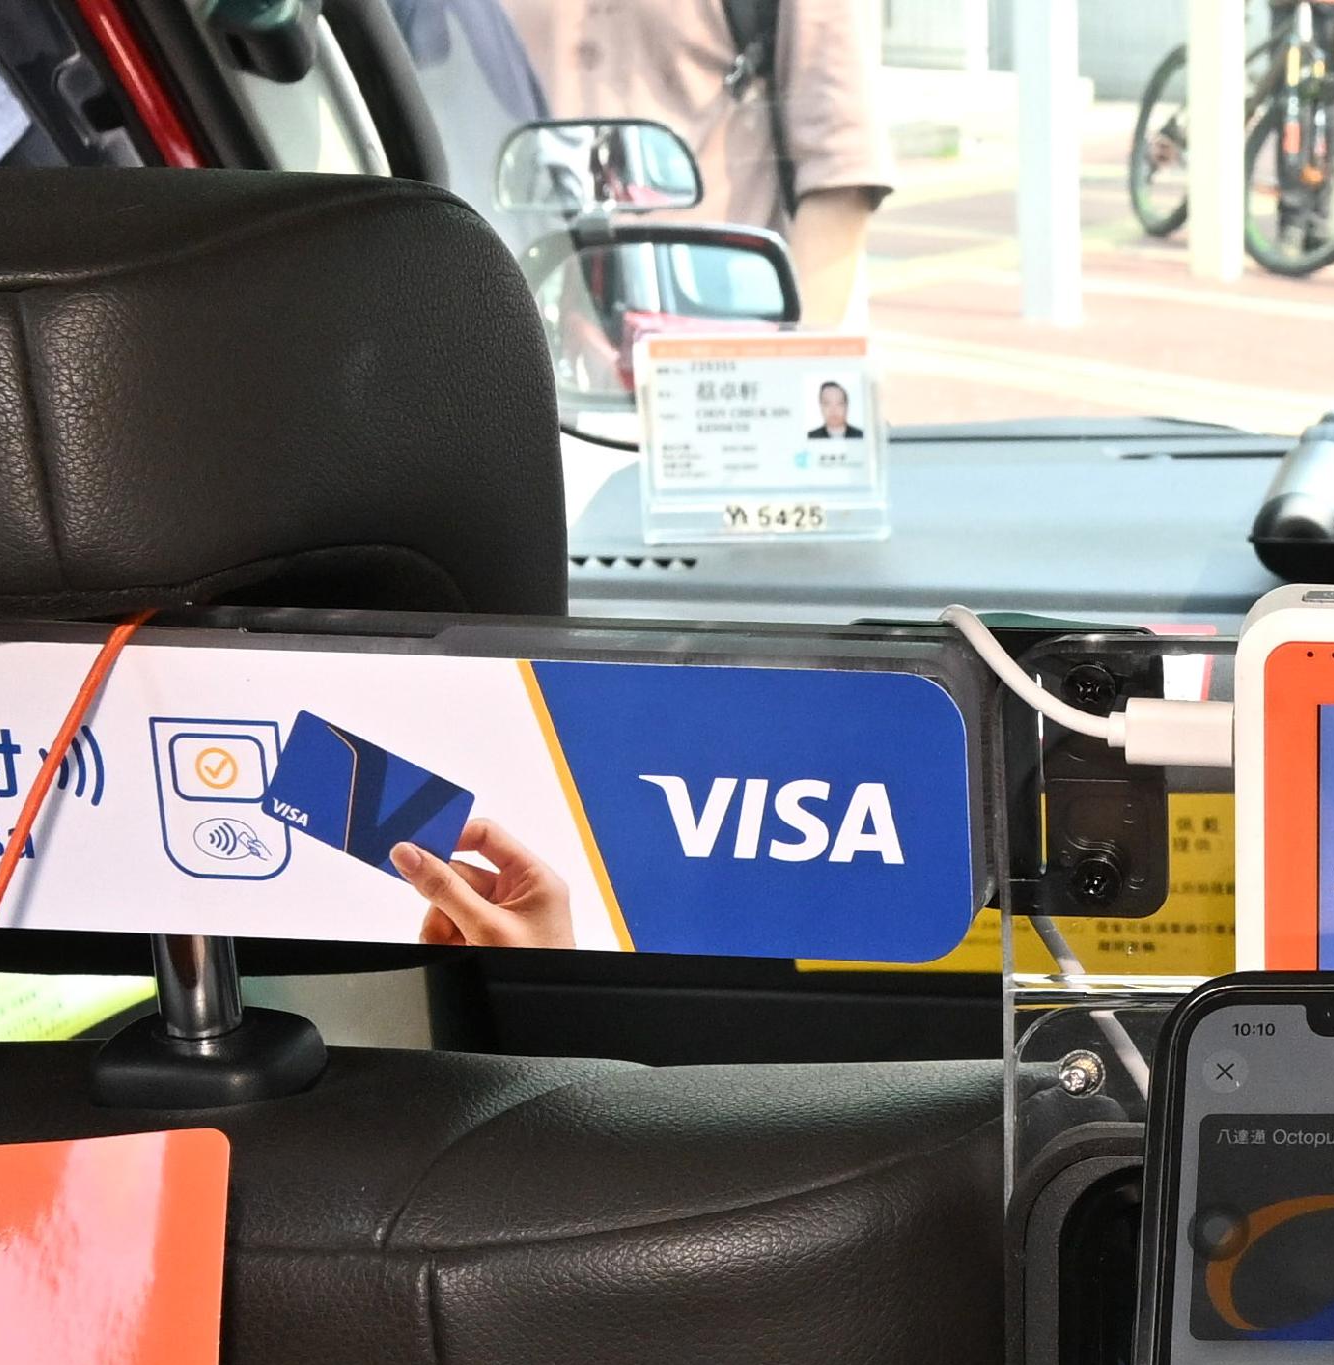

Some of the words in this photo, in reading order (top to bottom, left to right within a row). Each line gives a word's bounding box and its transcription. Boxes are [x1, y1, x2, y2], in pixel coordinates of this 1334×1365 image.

[273, 798, 309, 828] VISA
[639, 775, 906, 865] VISA
[1231, 1022, 1276, 1037] 10:10
[1216, 1128, 1266, 1146] 八達通
